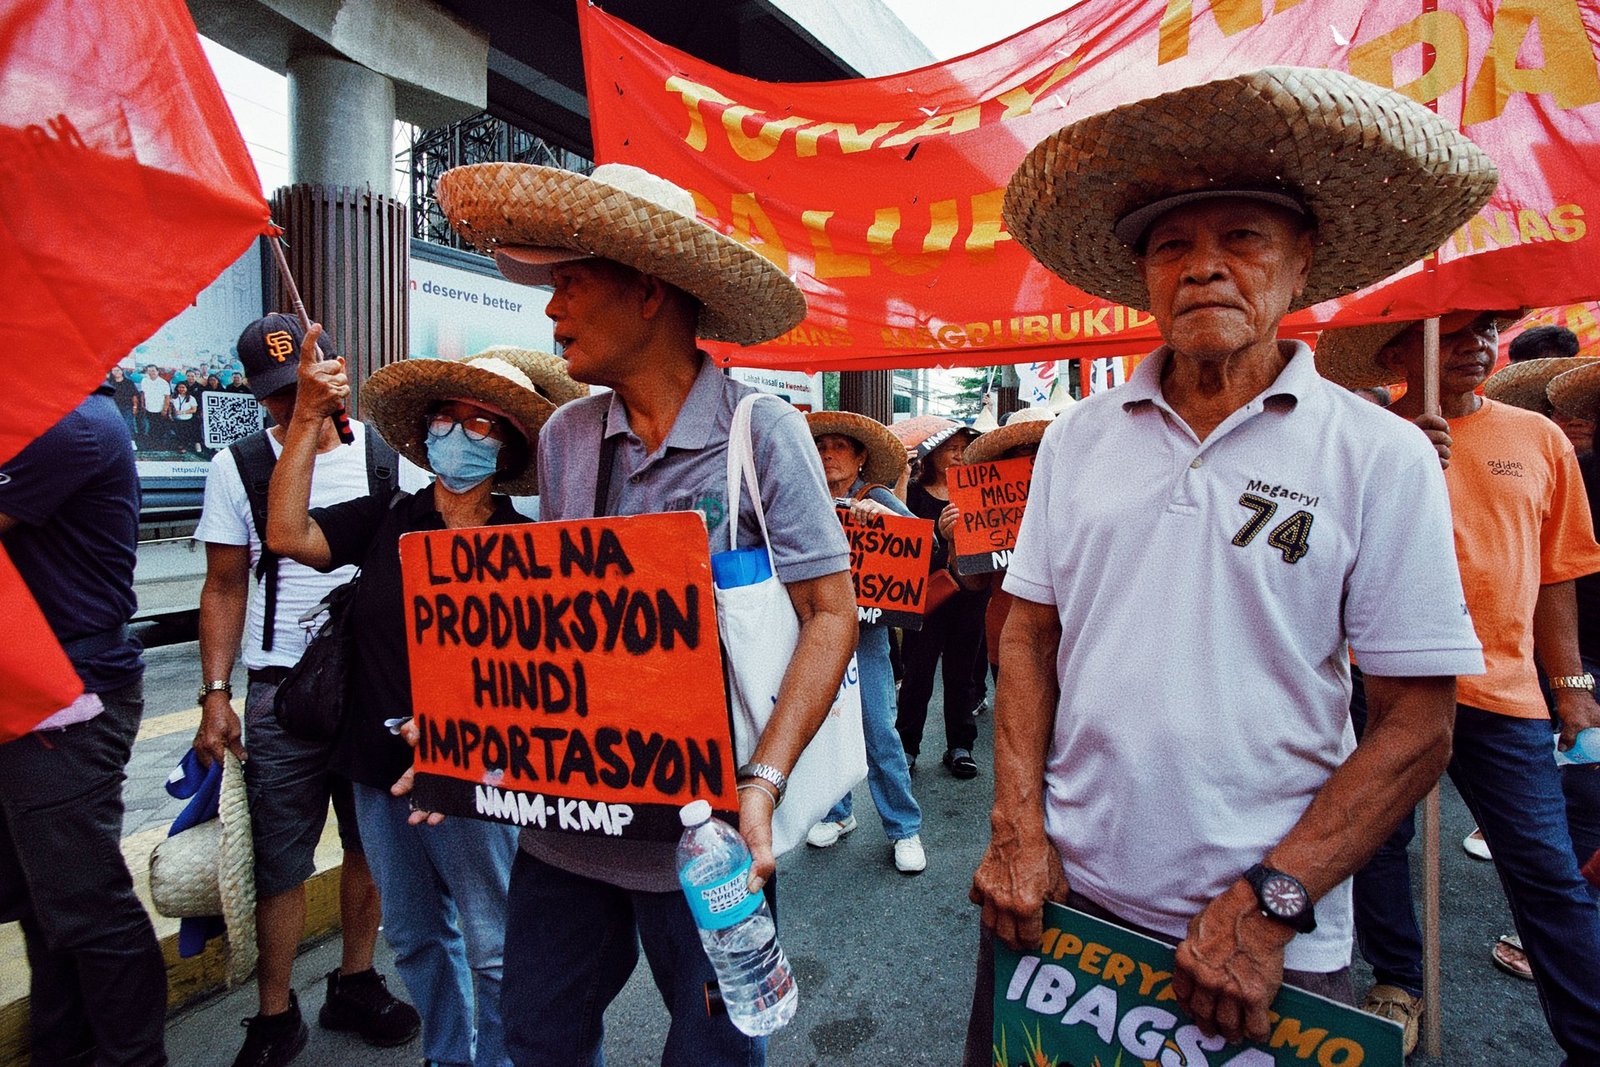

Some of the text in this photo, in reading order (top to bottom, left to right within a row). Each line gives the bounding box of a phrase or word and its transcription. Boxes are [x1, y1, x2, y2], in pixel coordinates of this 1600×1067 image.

[422, 280, 479, 304] deserve
[483, 293, 522, 313] better
[778, 381, 785, 389] sa
[957, 464, 1001, 489] LUPA
[1246, 480, 1320, 508] Megacryl
[964, 506, 1026, 533] PAGKA
[1231, 492, 1314, 564] 74
[424, 527, 634, 585] LOKAL NA
[414, 584, 699, 656] PRODUKSYON
[471, 656, 588, 718] HINDI
[419, 713, 724, 798] IMPORTASYON
